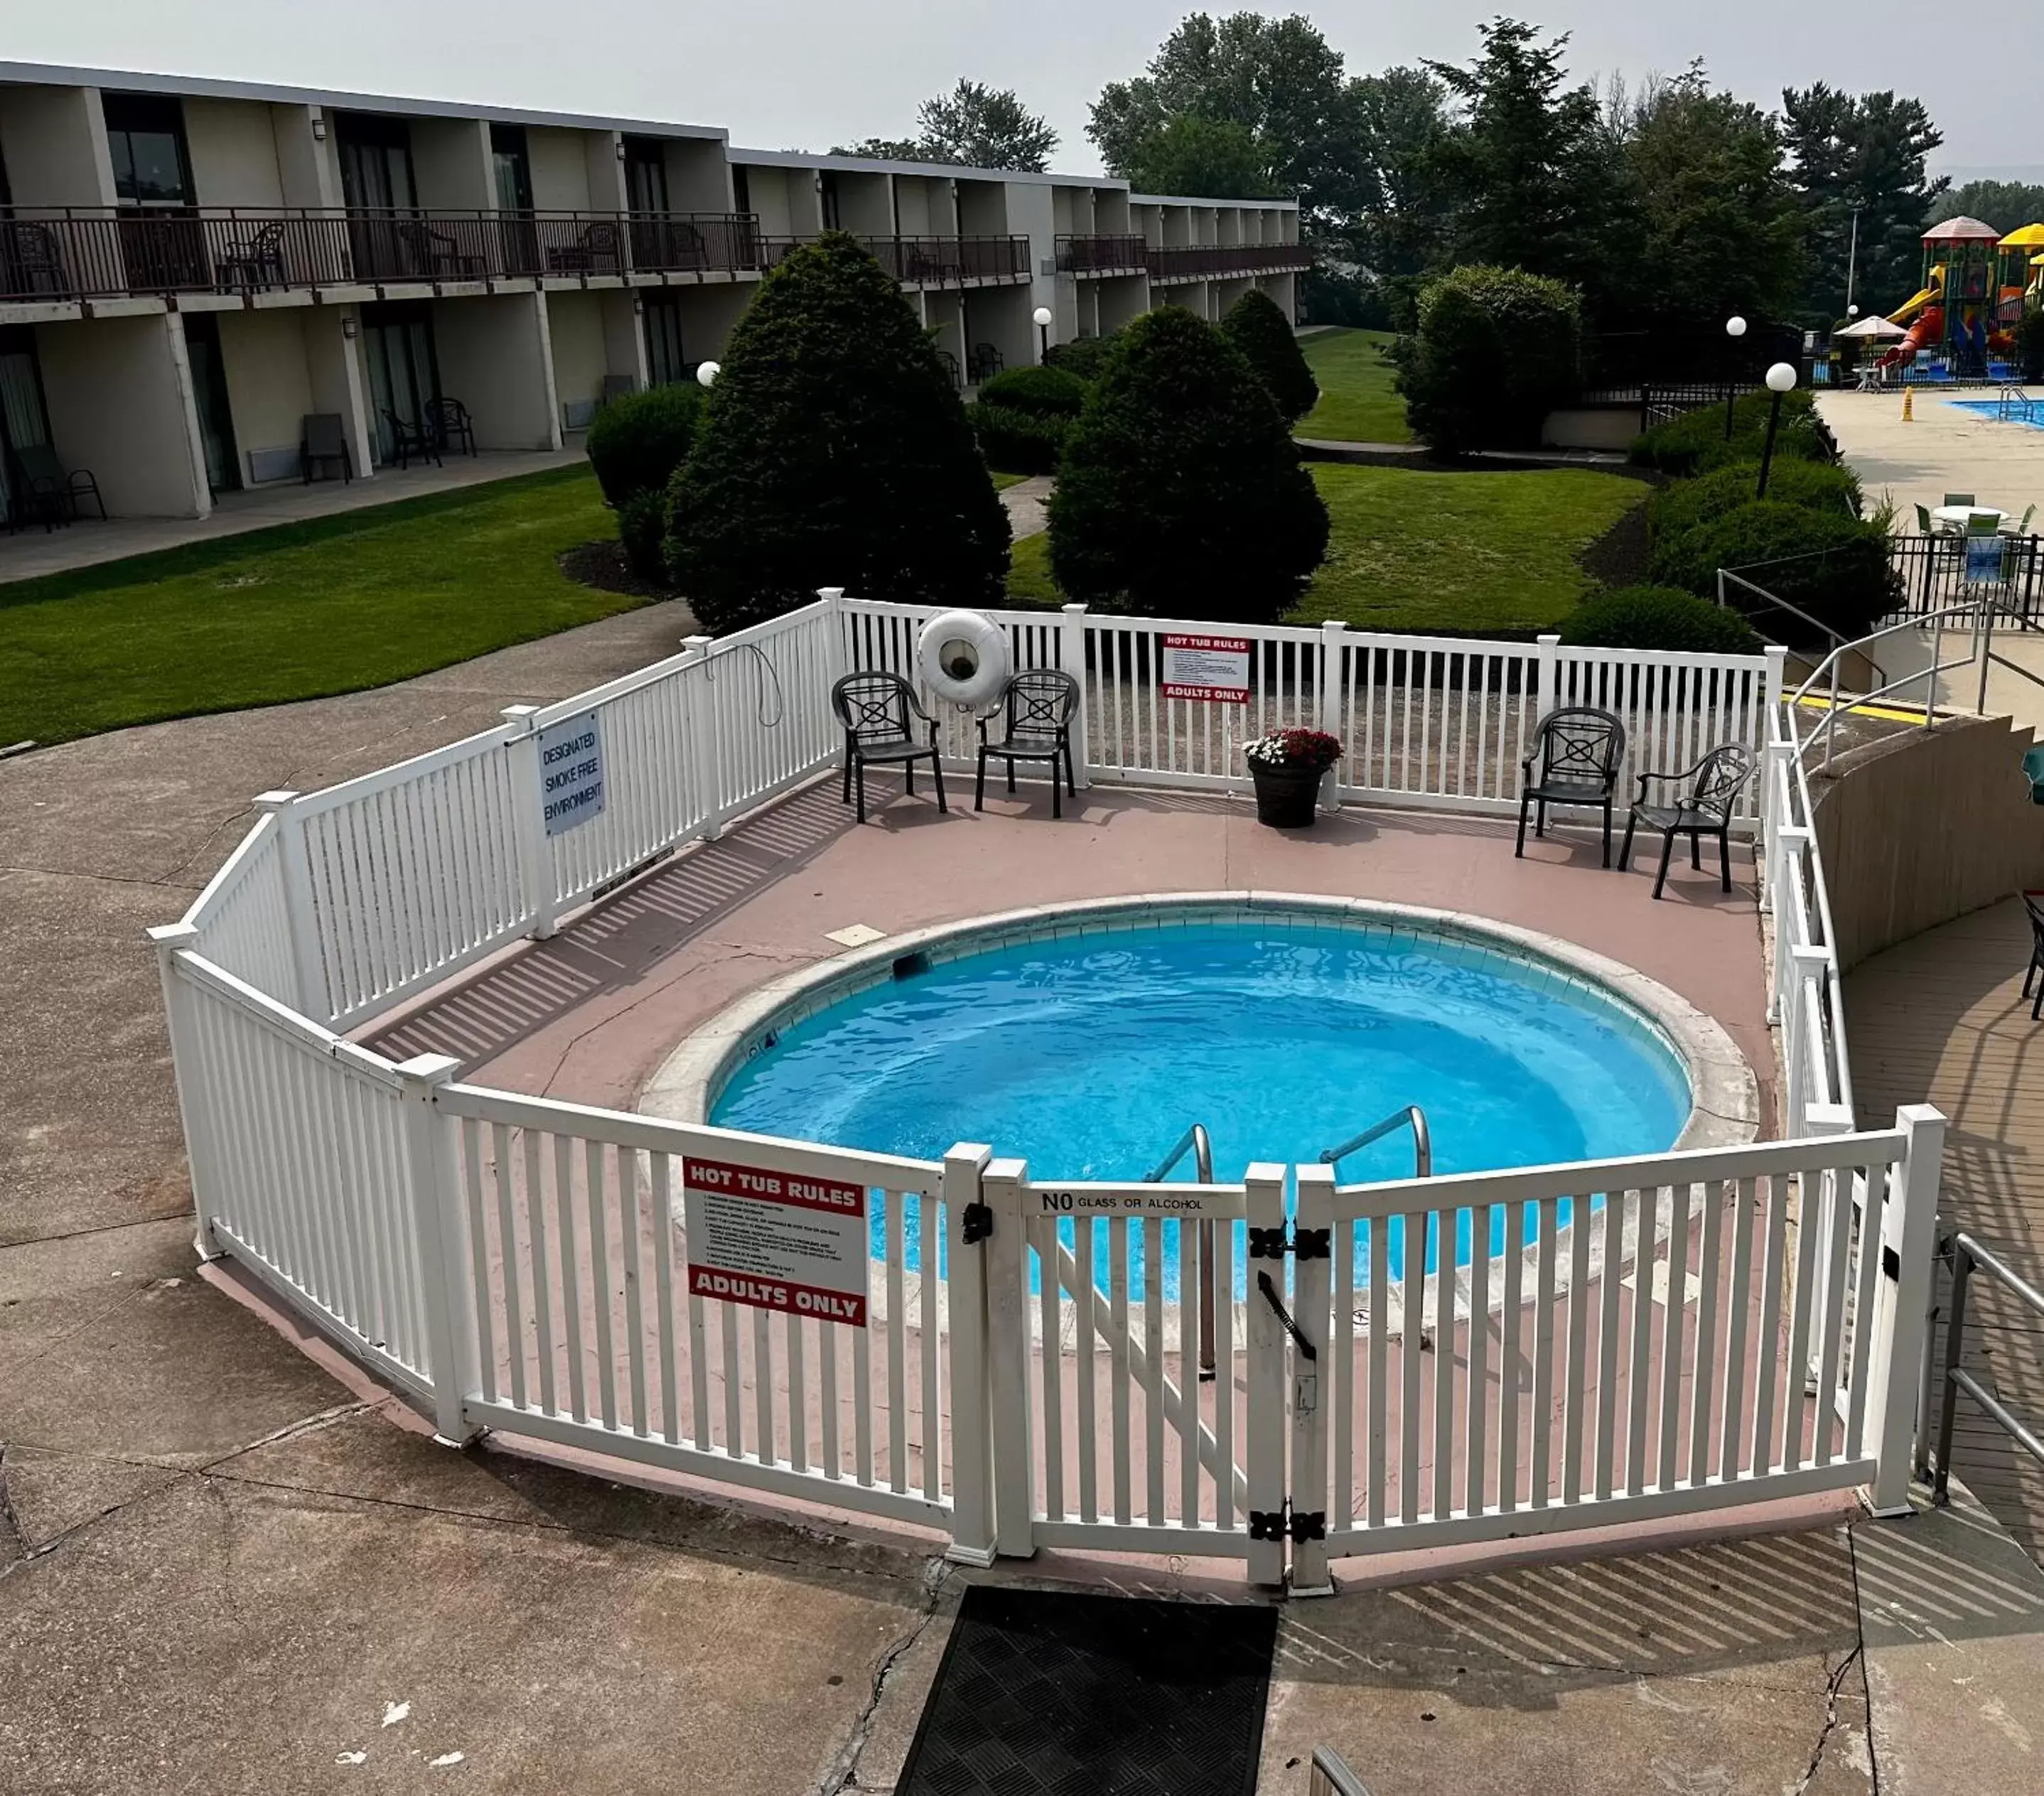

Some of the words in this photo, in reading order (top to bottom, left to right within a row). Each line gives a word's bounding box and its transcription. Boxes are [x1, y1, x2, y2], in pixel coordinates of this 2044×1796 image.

[1167, 687, 1210, 697] ADULTS
[1215, 692, 1244, 700] ONLY
[544, 733, 594, 765] DESIGNATED
[546, 767, 576, 792] SMOKE
[578, 758, 597, 778] FREE
[544, 782, 601, 820] ENVIRONMENT
[691, 1166, 731, 1185] HOT
[738, 1173, 781, 1193] TUB
[788, 1183, 855, 1206] RULES
[1043, 1193, 1072, 1210] NO
[1079, 1198, 1116, 1208] GLASS
[1124, 1199, 1141, 1208] OR
[1149, 1199, 1202, 1209] ALCOHOL
[697, 1274, 787, 1304] ADULTS
[796, 1292, 857, 1317] ONLY
